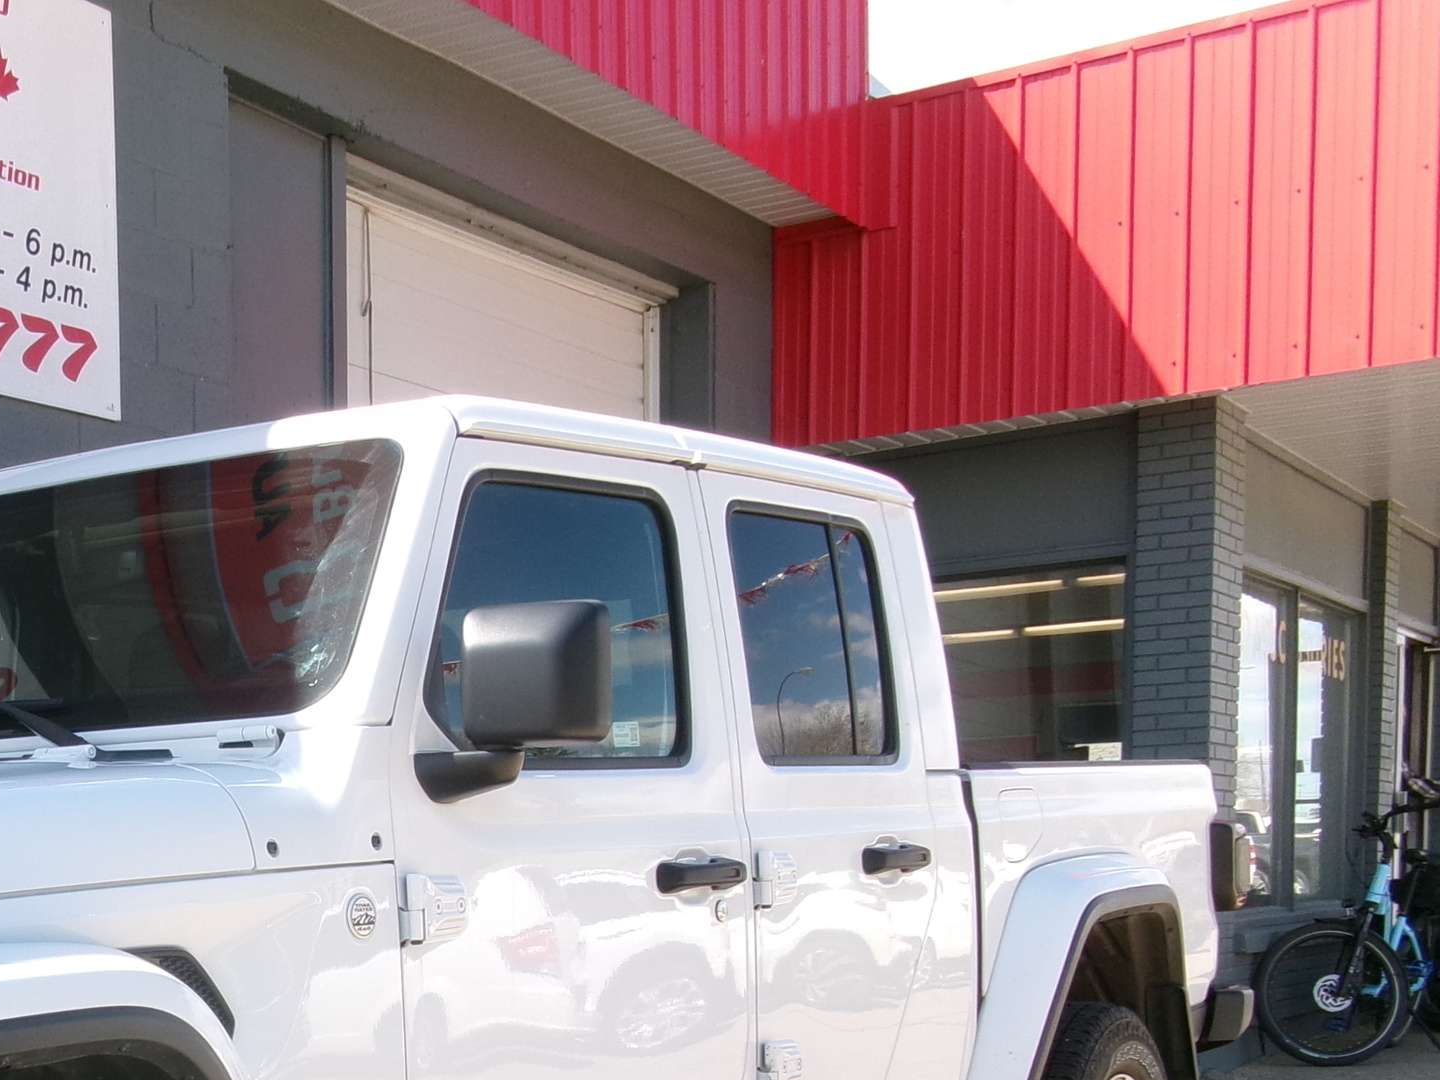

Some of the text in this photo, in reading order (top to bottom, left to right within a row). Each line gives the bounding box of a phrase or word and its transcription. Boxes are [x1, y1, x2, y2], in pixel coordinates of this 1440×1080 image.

[25, 228, 41, 256] 6
[50, 242, 97, 274] p.m.
[15, 265, 32, 293] 4
[41, 278, 88, 309] p.m.
